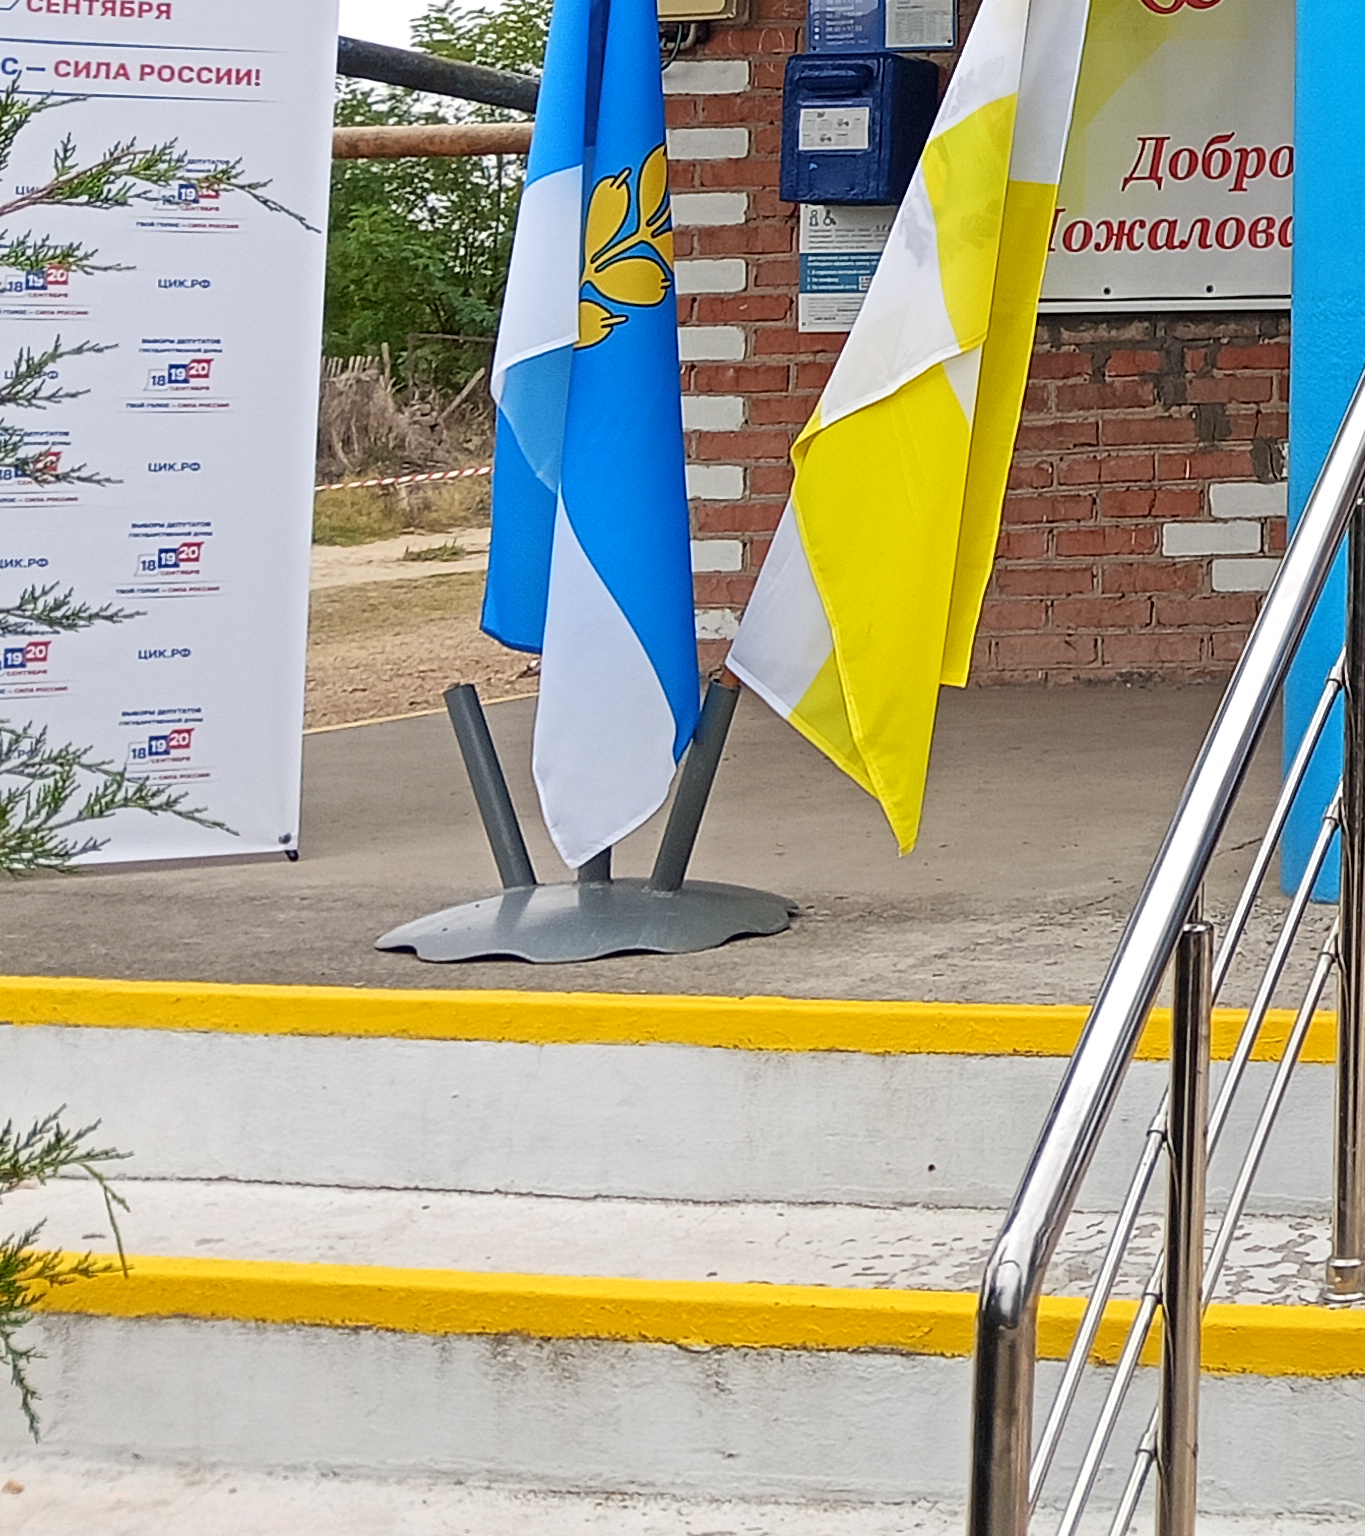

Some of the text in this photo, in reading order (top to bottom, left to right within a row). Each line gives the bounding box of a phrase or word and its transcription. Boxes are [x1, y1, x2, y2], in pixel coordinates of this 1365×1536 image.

[53, 60, 131, 82] СИЛА
[139, 63, 262, 87] РОССИИ!
[1121, 132, 1295, 192] Добро
[47, 268, 67, 281] 20
[7, 281, 24, 293] 18
[158, 277, 212, 290] ЦИК.РФ
[169, 368, 187, 381] 19
[188, 362, 209, 375] 20
[151, 374, 167, 386] 18
[147, 461, 201, 473] ЦИК.РФ
[178, 545, 199, 559] 20
[140, 559, 157, 571] 18
[159, 552, 177, 566] 19
[6, 651, 23, 664] 19
[26, 645, 47, 658] 20
[138, 648, 192, 660] ЦИК.РФ
[150, 739, 168, 752] 19
[169, 732, 190, 746] 20
[131, 747, 148, 760] 18
